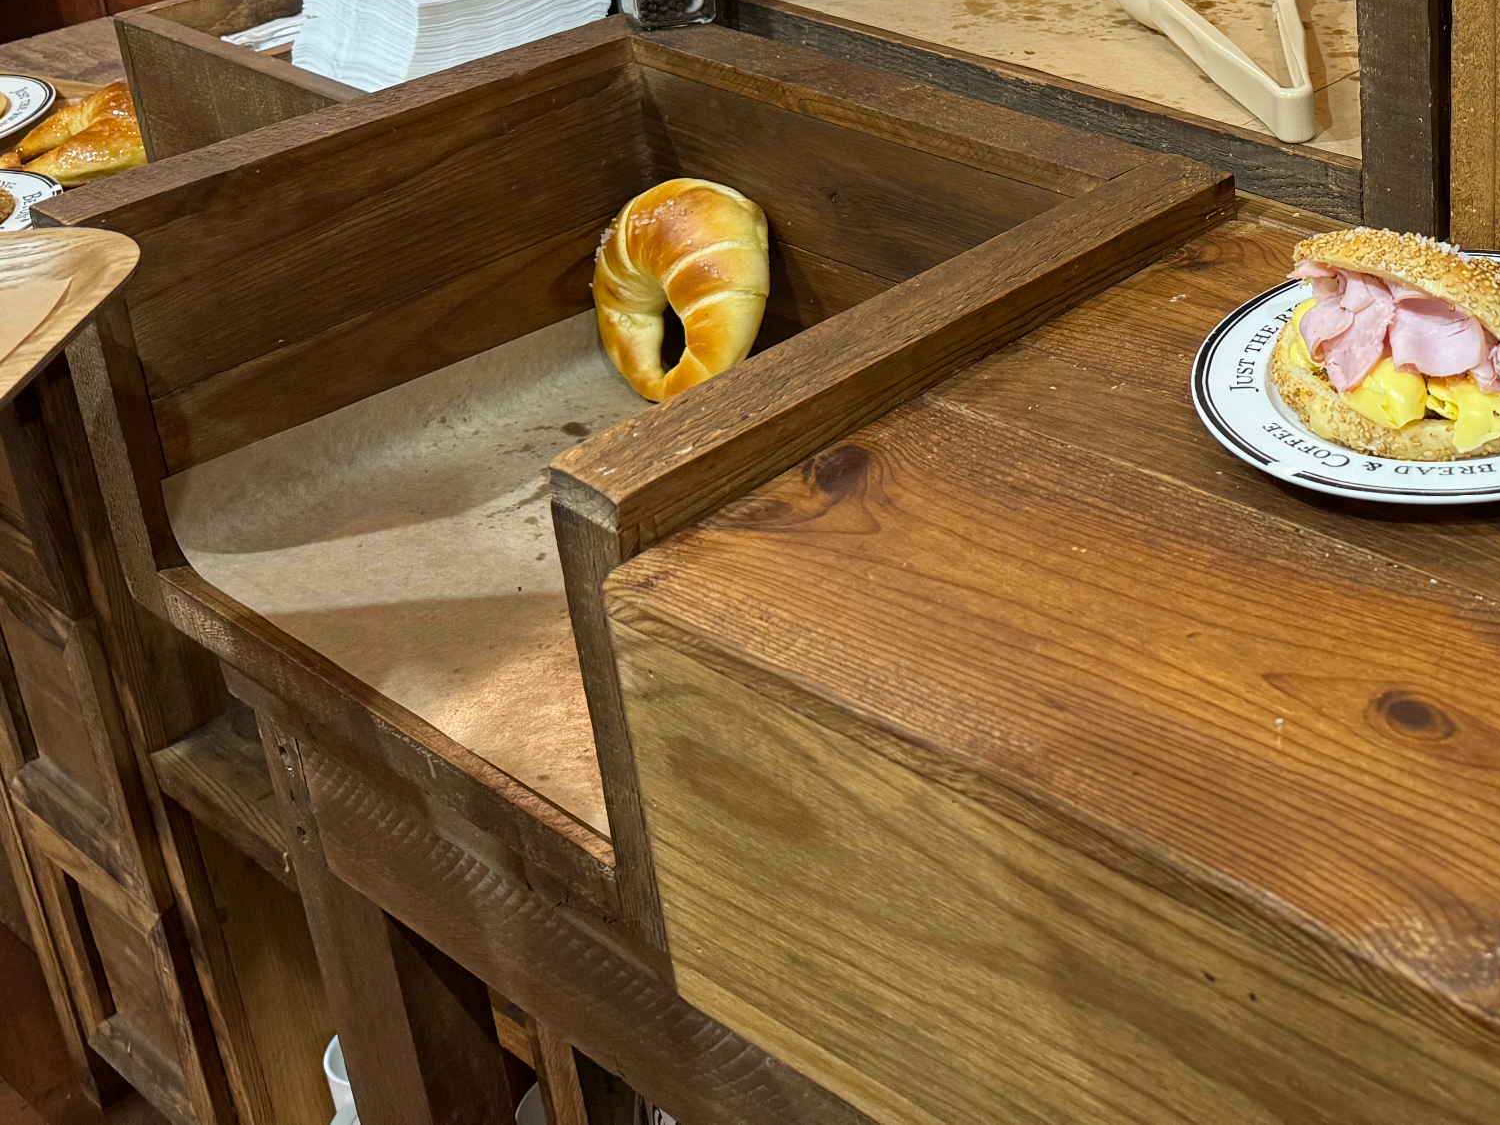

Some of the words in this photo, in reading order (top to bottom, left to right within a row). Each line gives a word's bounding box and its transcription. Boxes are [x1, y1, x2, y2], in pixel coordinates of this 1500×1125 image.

[1244, 324, 1279, 354] THE
[1229, 358, 1260, 393] JUST
[1262, 422, 1351, 469] COFFEE
[1363, 461, 1384, 472] &
[1394, 462, 1497, 476] BREAD
